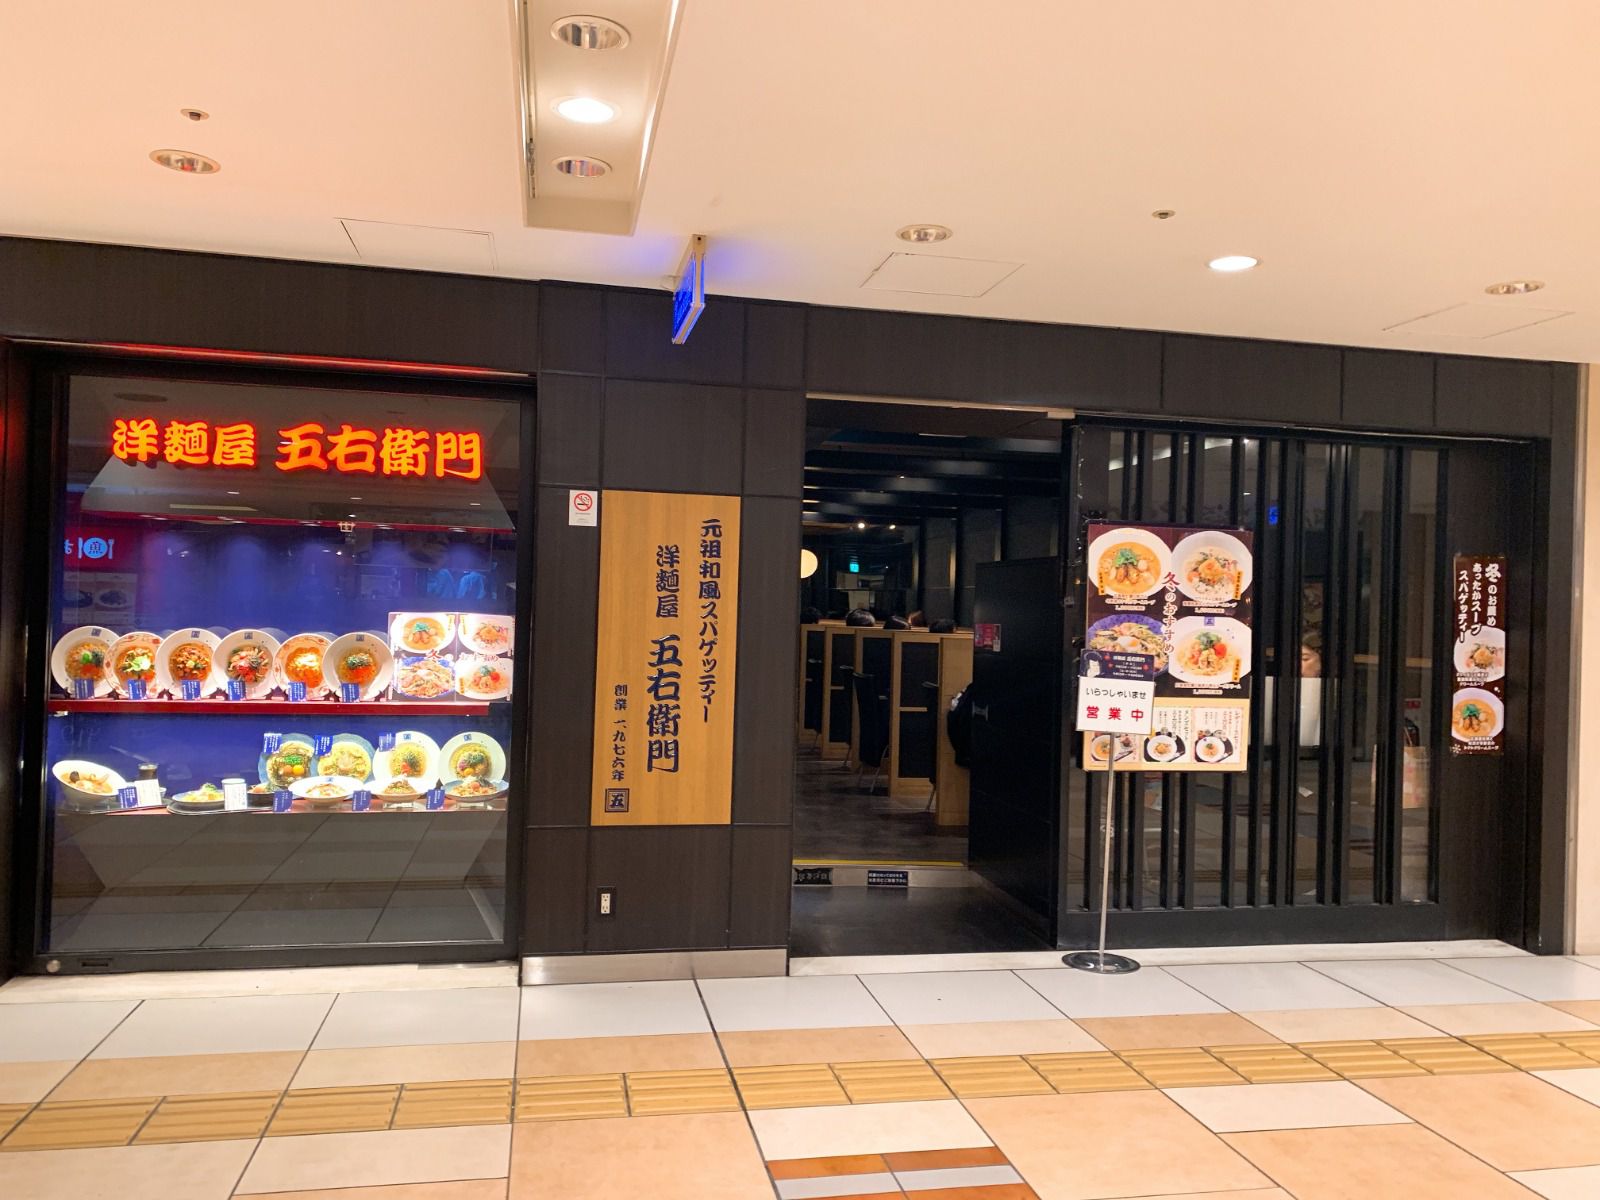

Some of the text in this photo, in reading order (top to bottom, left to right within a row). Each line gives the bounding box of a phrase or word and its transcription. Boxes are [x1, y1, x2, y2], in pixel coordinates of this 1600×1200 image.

[275, 423, 482, 479] 五右衛門
[698, 519, 722, 723] 元祖和風スパゲッティー
[1162, 571, 1180, 654] 冬のおすすめ
[1458, 570, 1469, 643] スパゲッティー
[1471, 562, 1482, 636] あったかスープ
[614, 684, 628, 711] 創業
[647, 634, 683, 773] 五右衛門
[1086, 687, 1146, 700] いらっしゃいませ
[1086, 705, 1144, 722] 営業中
